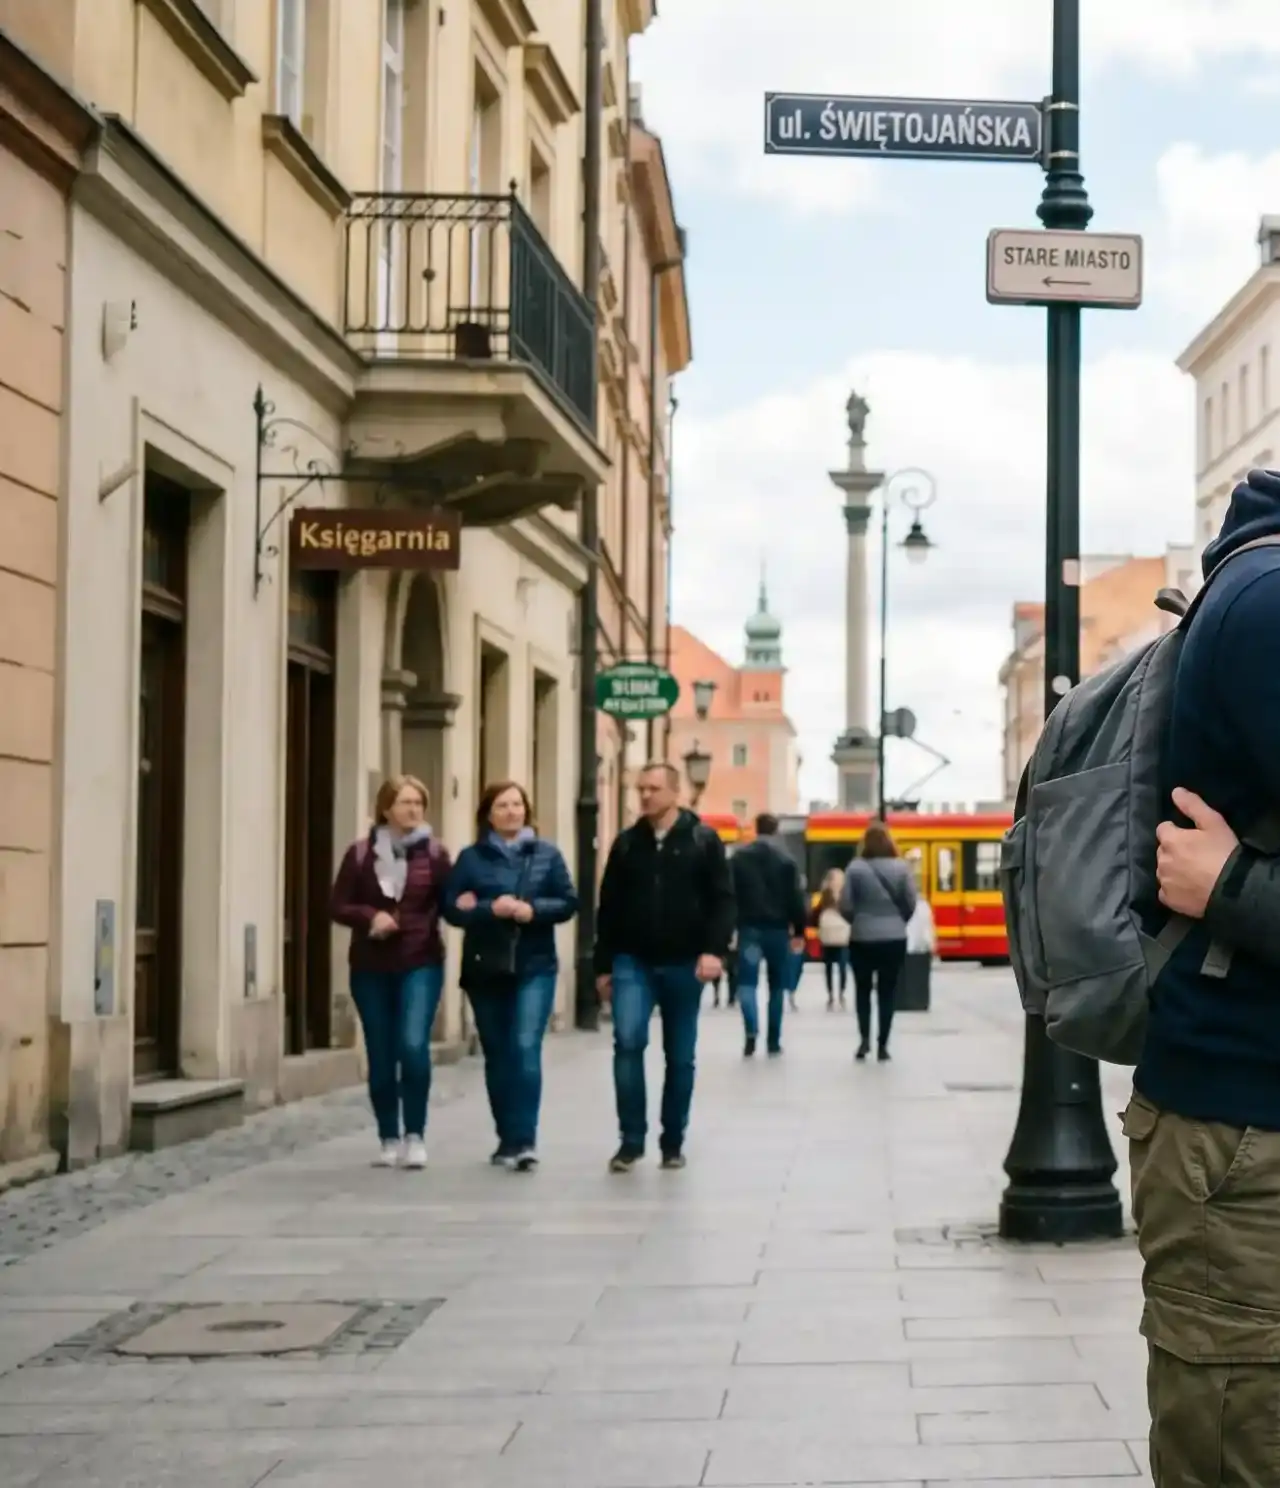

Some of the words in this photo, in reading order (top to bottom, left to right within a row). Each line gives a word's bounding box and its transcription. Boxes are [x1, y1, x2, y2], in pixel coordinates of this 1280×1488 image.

[779, 109, 811, 139] ul.
[818, 101, 1032, 150] ŚWIĘTOJAŃSKA
[1003, 246, 1060, 267] STARE
[1064, 248, 1131, 271] MIASTO
[299, 521, 451, 557] Księgarnia
